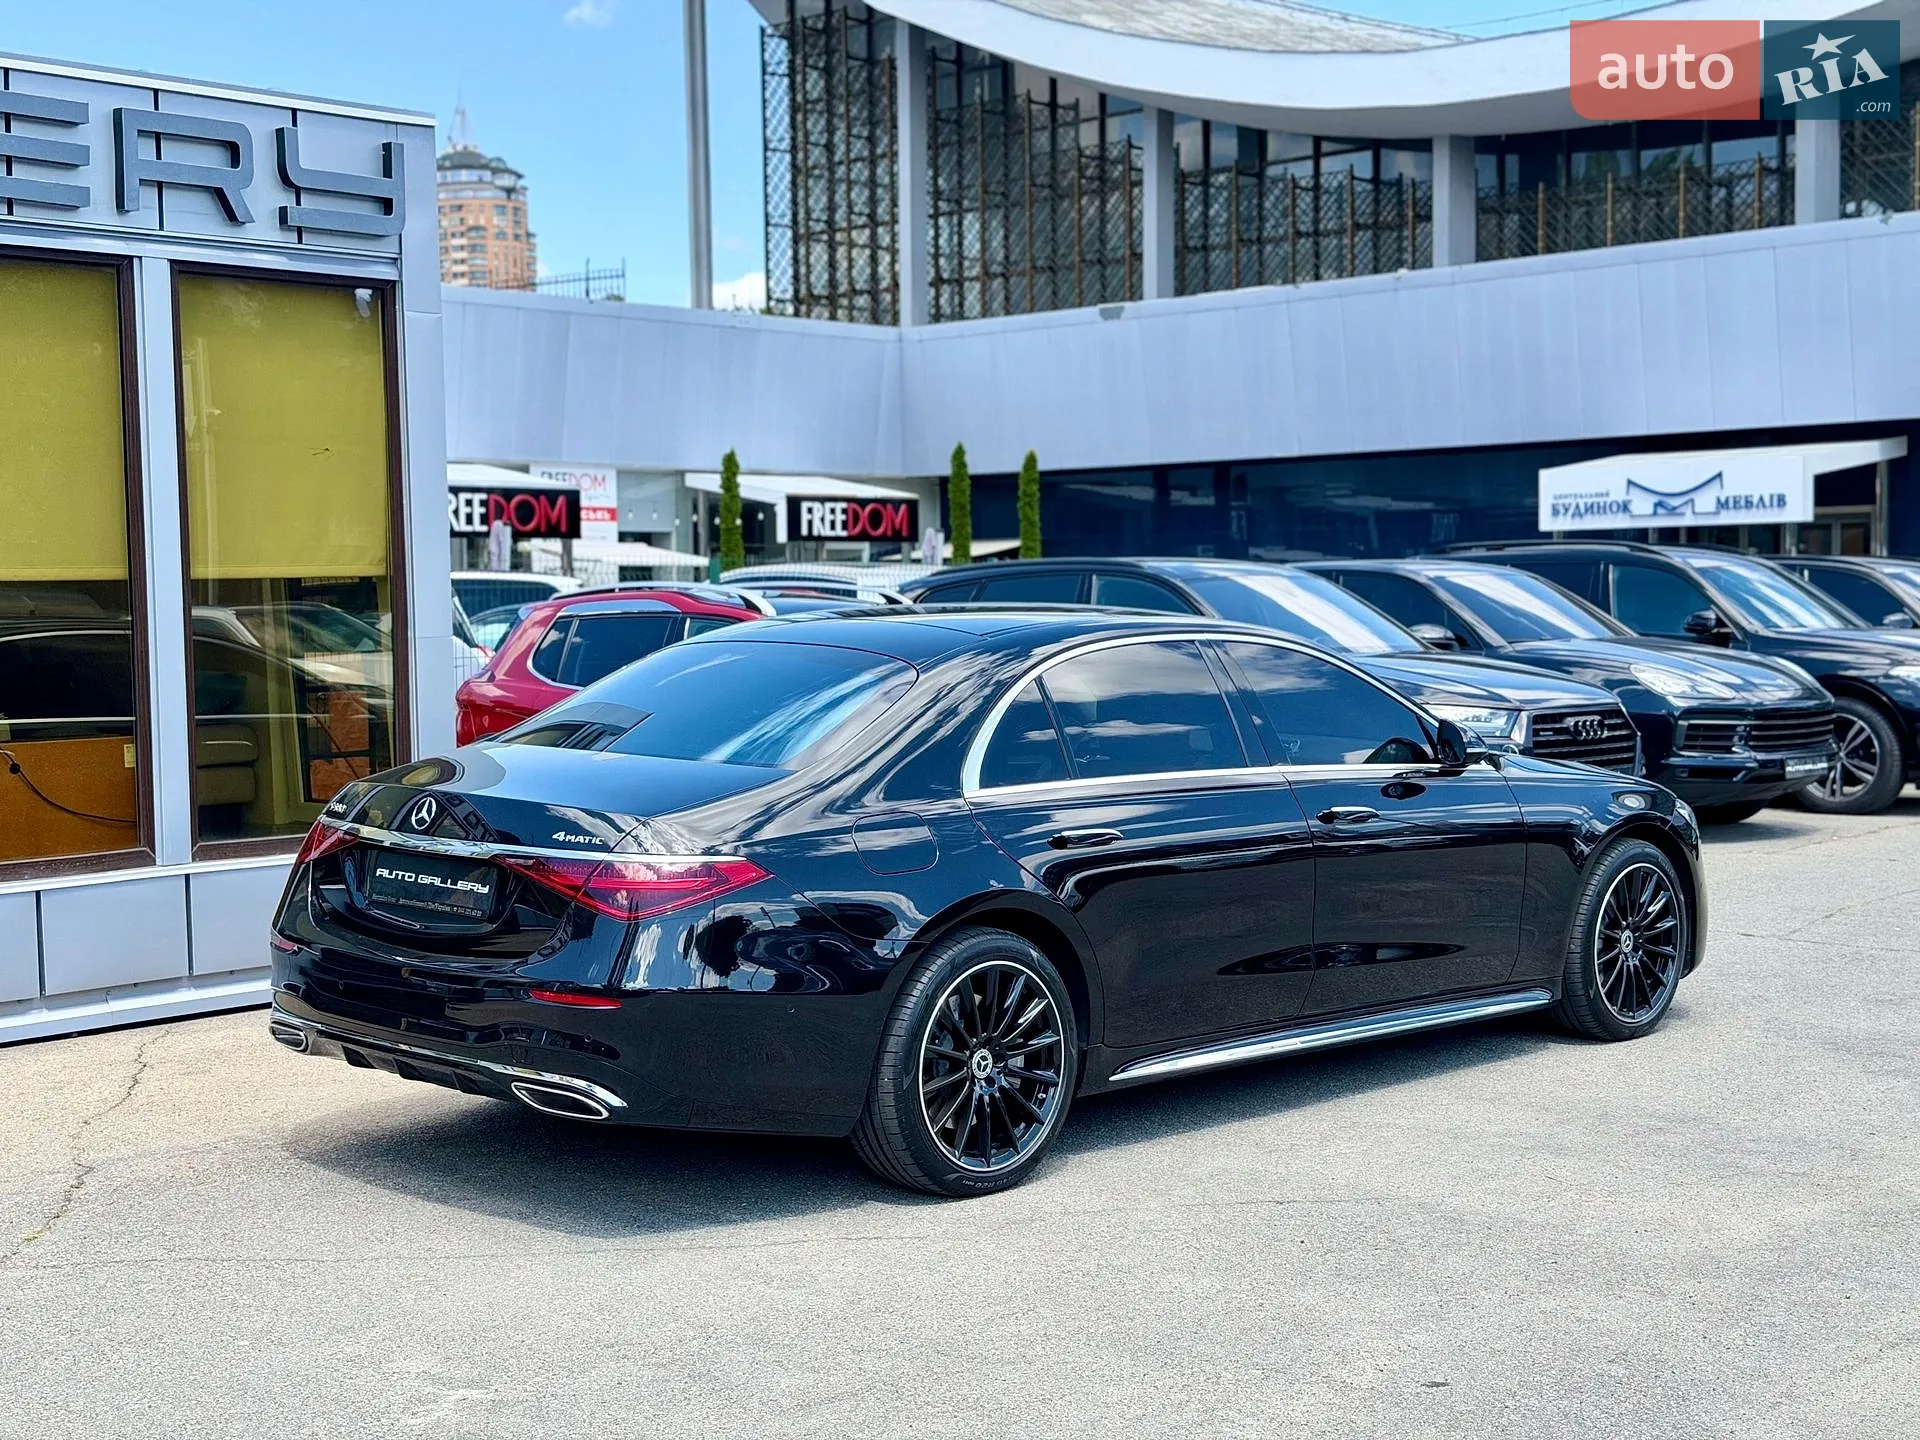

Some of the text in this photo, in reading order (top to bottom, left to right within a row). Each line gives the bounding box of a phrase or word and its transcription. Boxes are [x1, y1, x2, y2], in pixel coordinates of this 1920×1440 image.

[0, 91, 405, 237] ERY
[448, 492, 567, 533] REEDOM
[800, 501, 909, 537] FREEDOM
[1551, 493, 1787, 519] БУДИНОК МЕБЛІВ
[552, 831, 605, 845] 4MATIC
[375, 867, 490, 894] AUTO GALLERY
